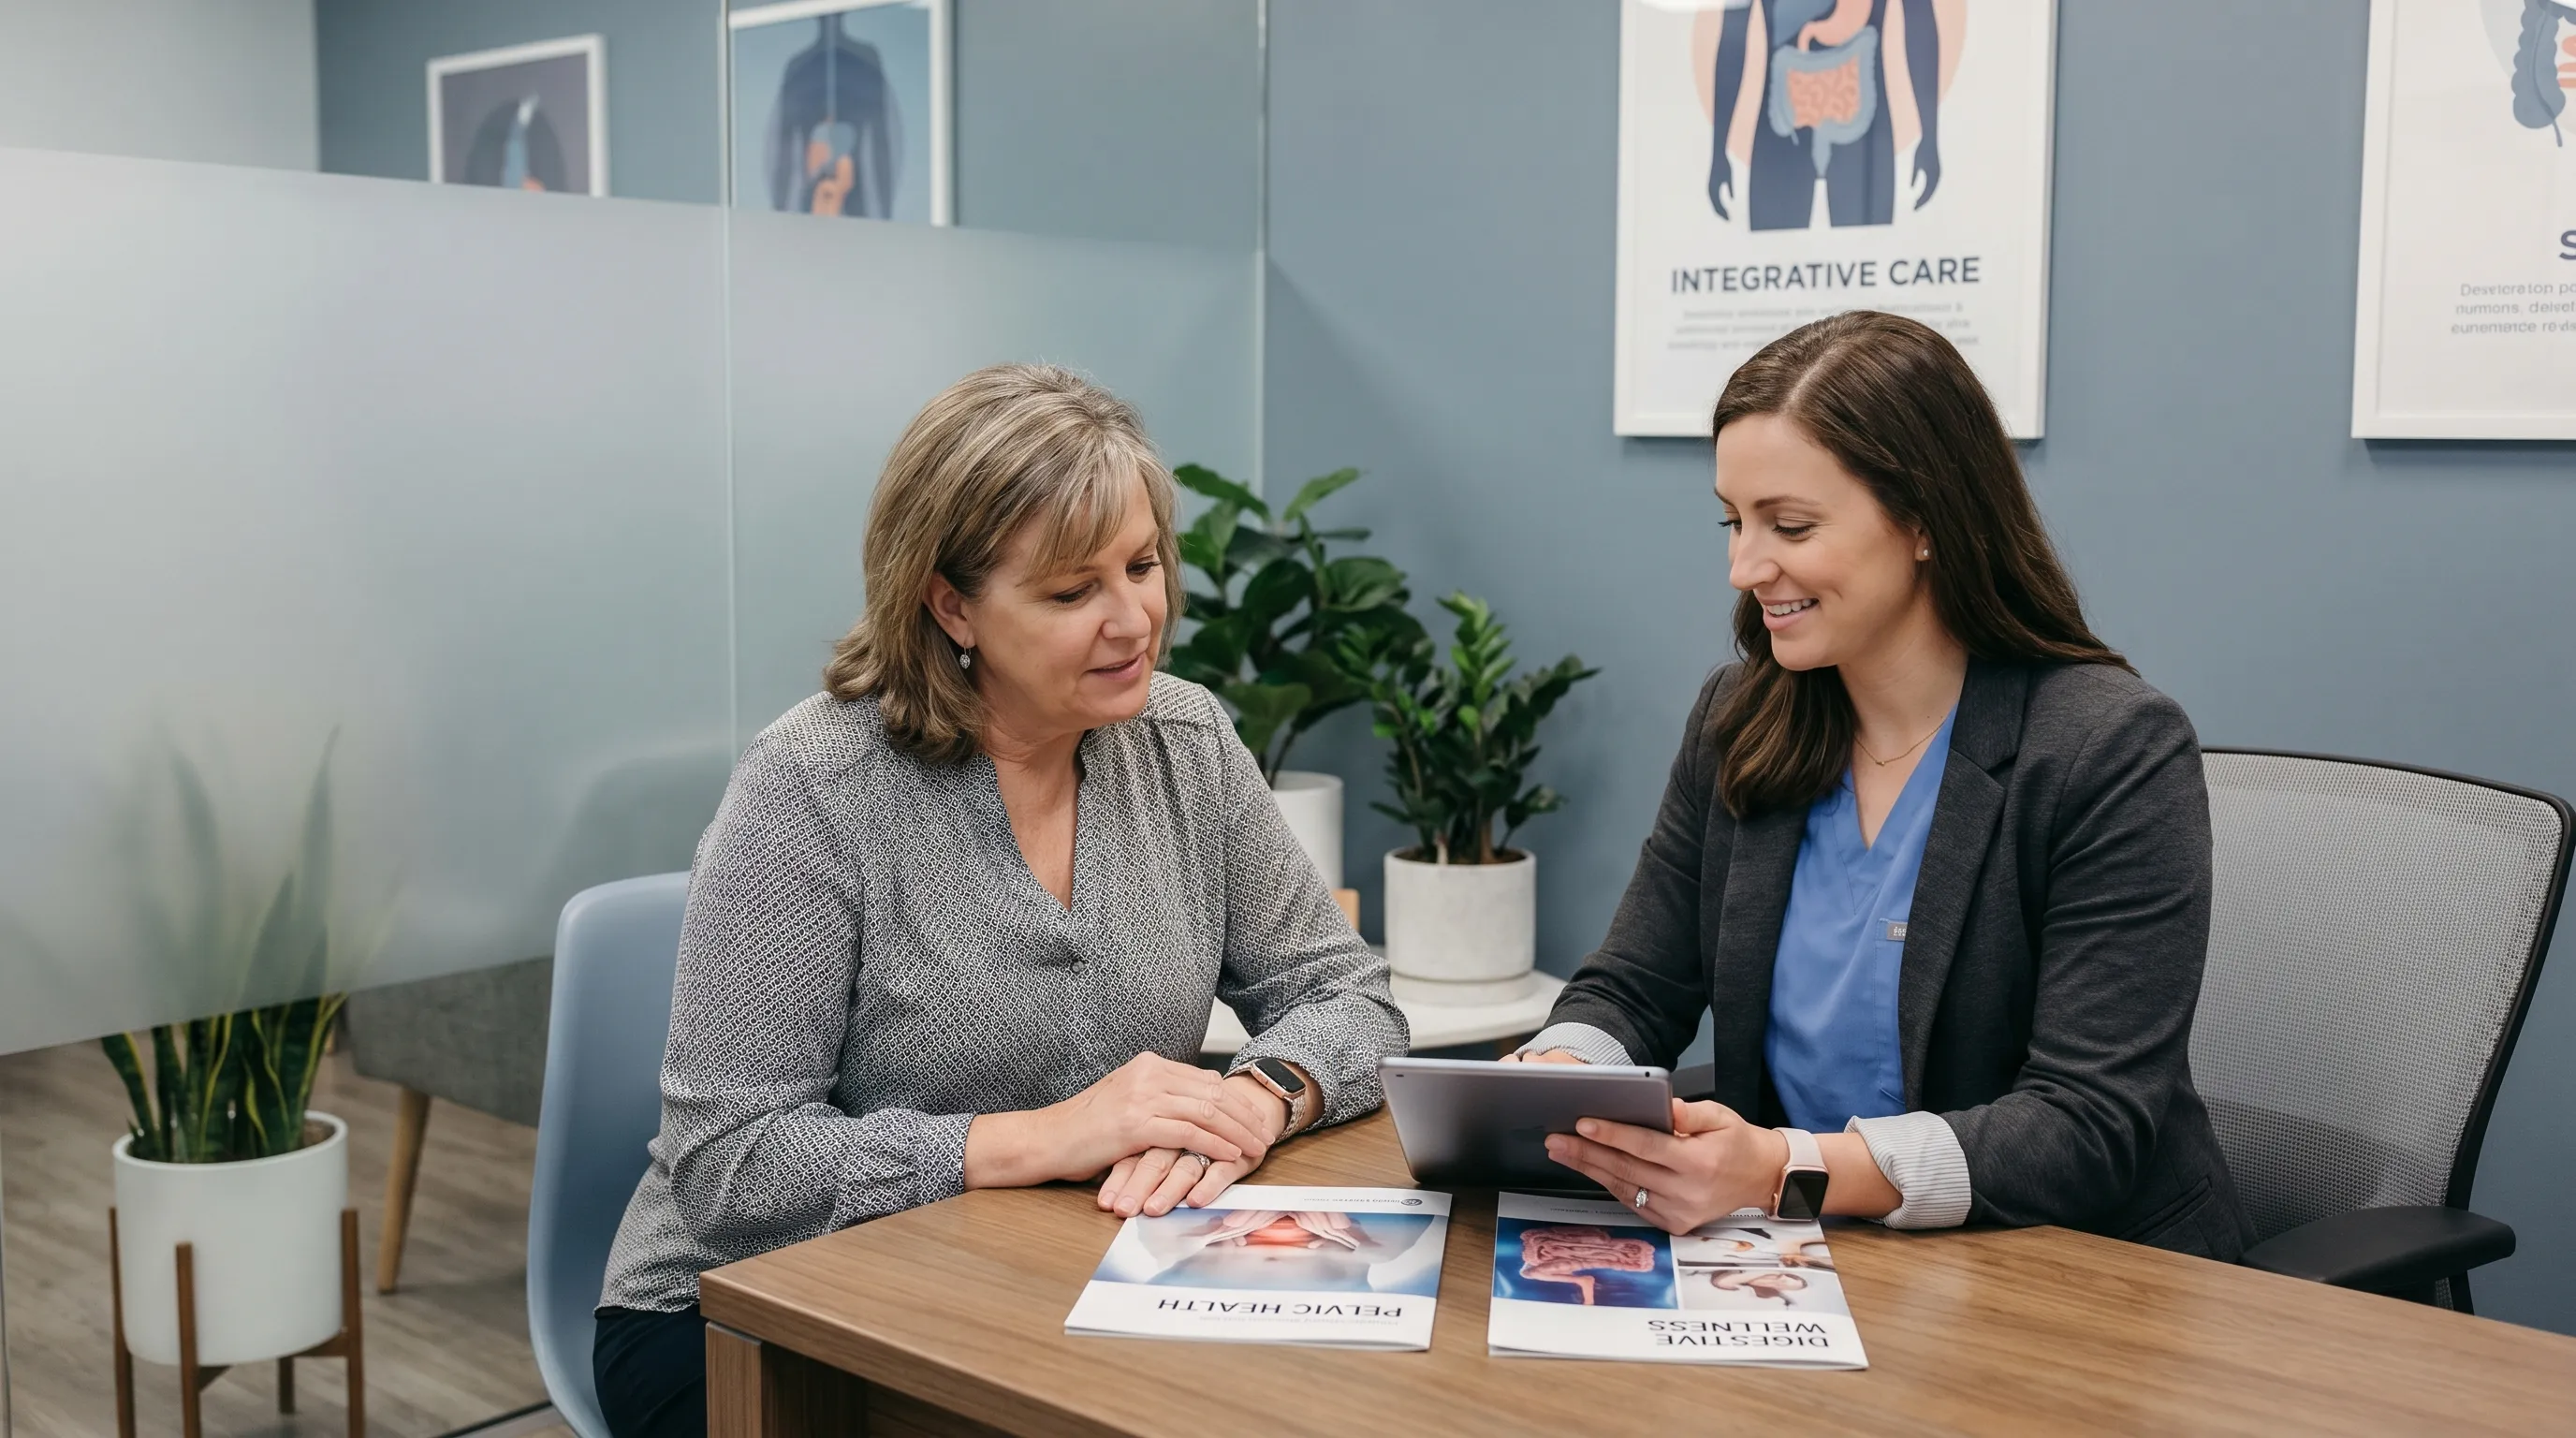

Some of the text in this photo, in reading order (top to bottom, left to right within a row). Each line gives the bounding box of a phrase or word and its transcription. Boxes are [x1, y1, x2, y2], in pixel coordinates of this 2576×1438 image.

[1672, 257, 1982, 294] INTEGRATIVE CARE
[1157, 1299, 1402, 1317] PELVIC HEALTH
[1647, 1320, 1826, 1334] WELLNESS
[1655, 1333, 1829, 1348] DIGESTIVE
